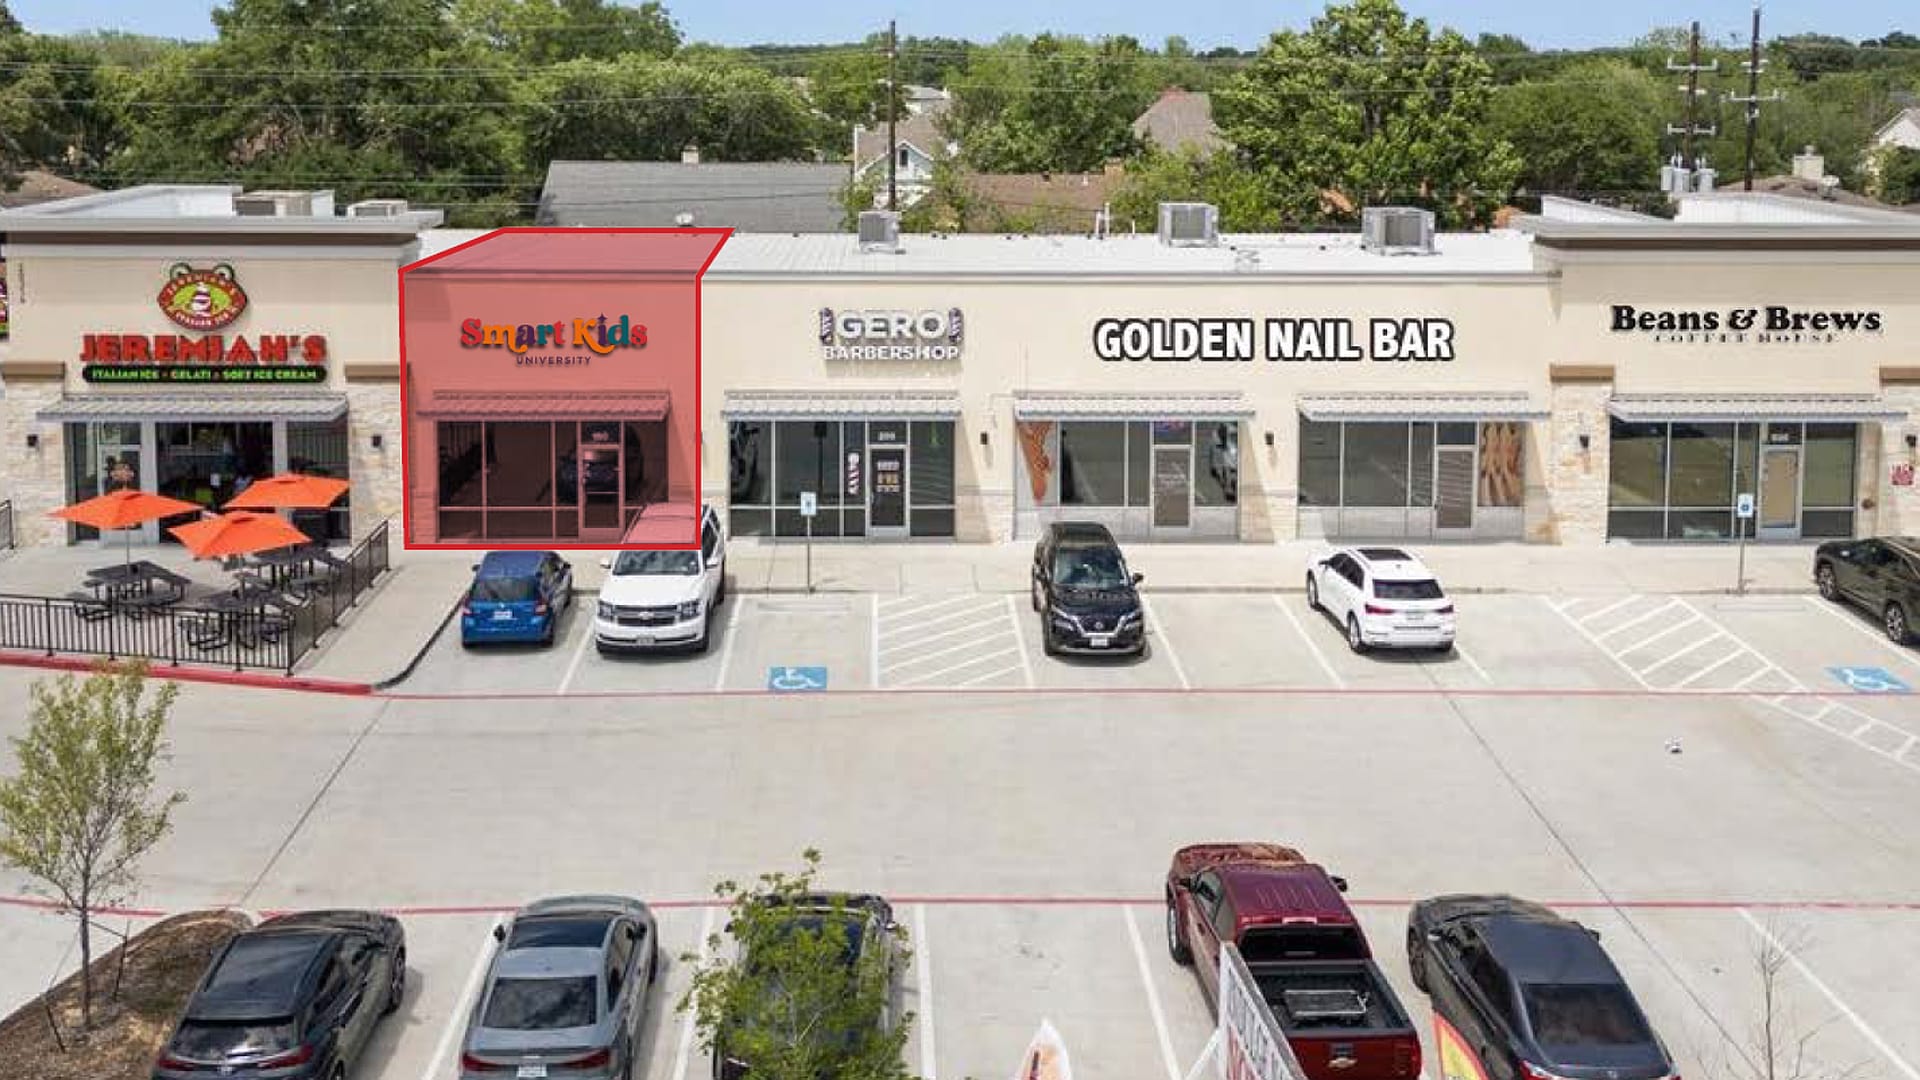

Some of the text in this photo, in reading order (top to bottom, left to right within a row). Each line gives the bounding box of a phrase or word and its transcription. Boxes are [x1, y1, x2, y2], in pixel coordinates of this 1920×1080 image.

[837, 311, 946, 339] GERO
[1611, 305, 1881, 331] Beans & Brews
[80, 334, 327, 362] JEREMIAH'S
[824, 345, 960, 360] BARBERSHOP
[1094, 318, 1454, 361] GOLDEN NAIL BAR
[92, 368, 317, 380] ITALIAN ICE GELATI SOFT ICE CREAM
